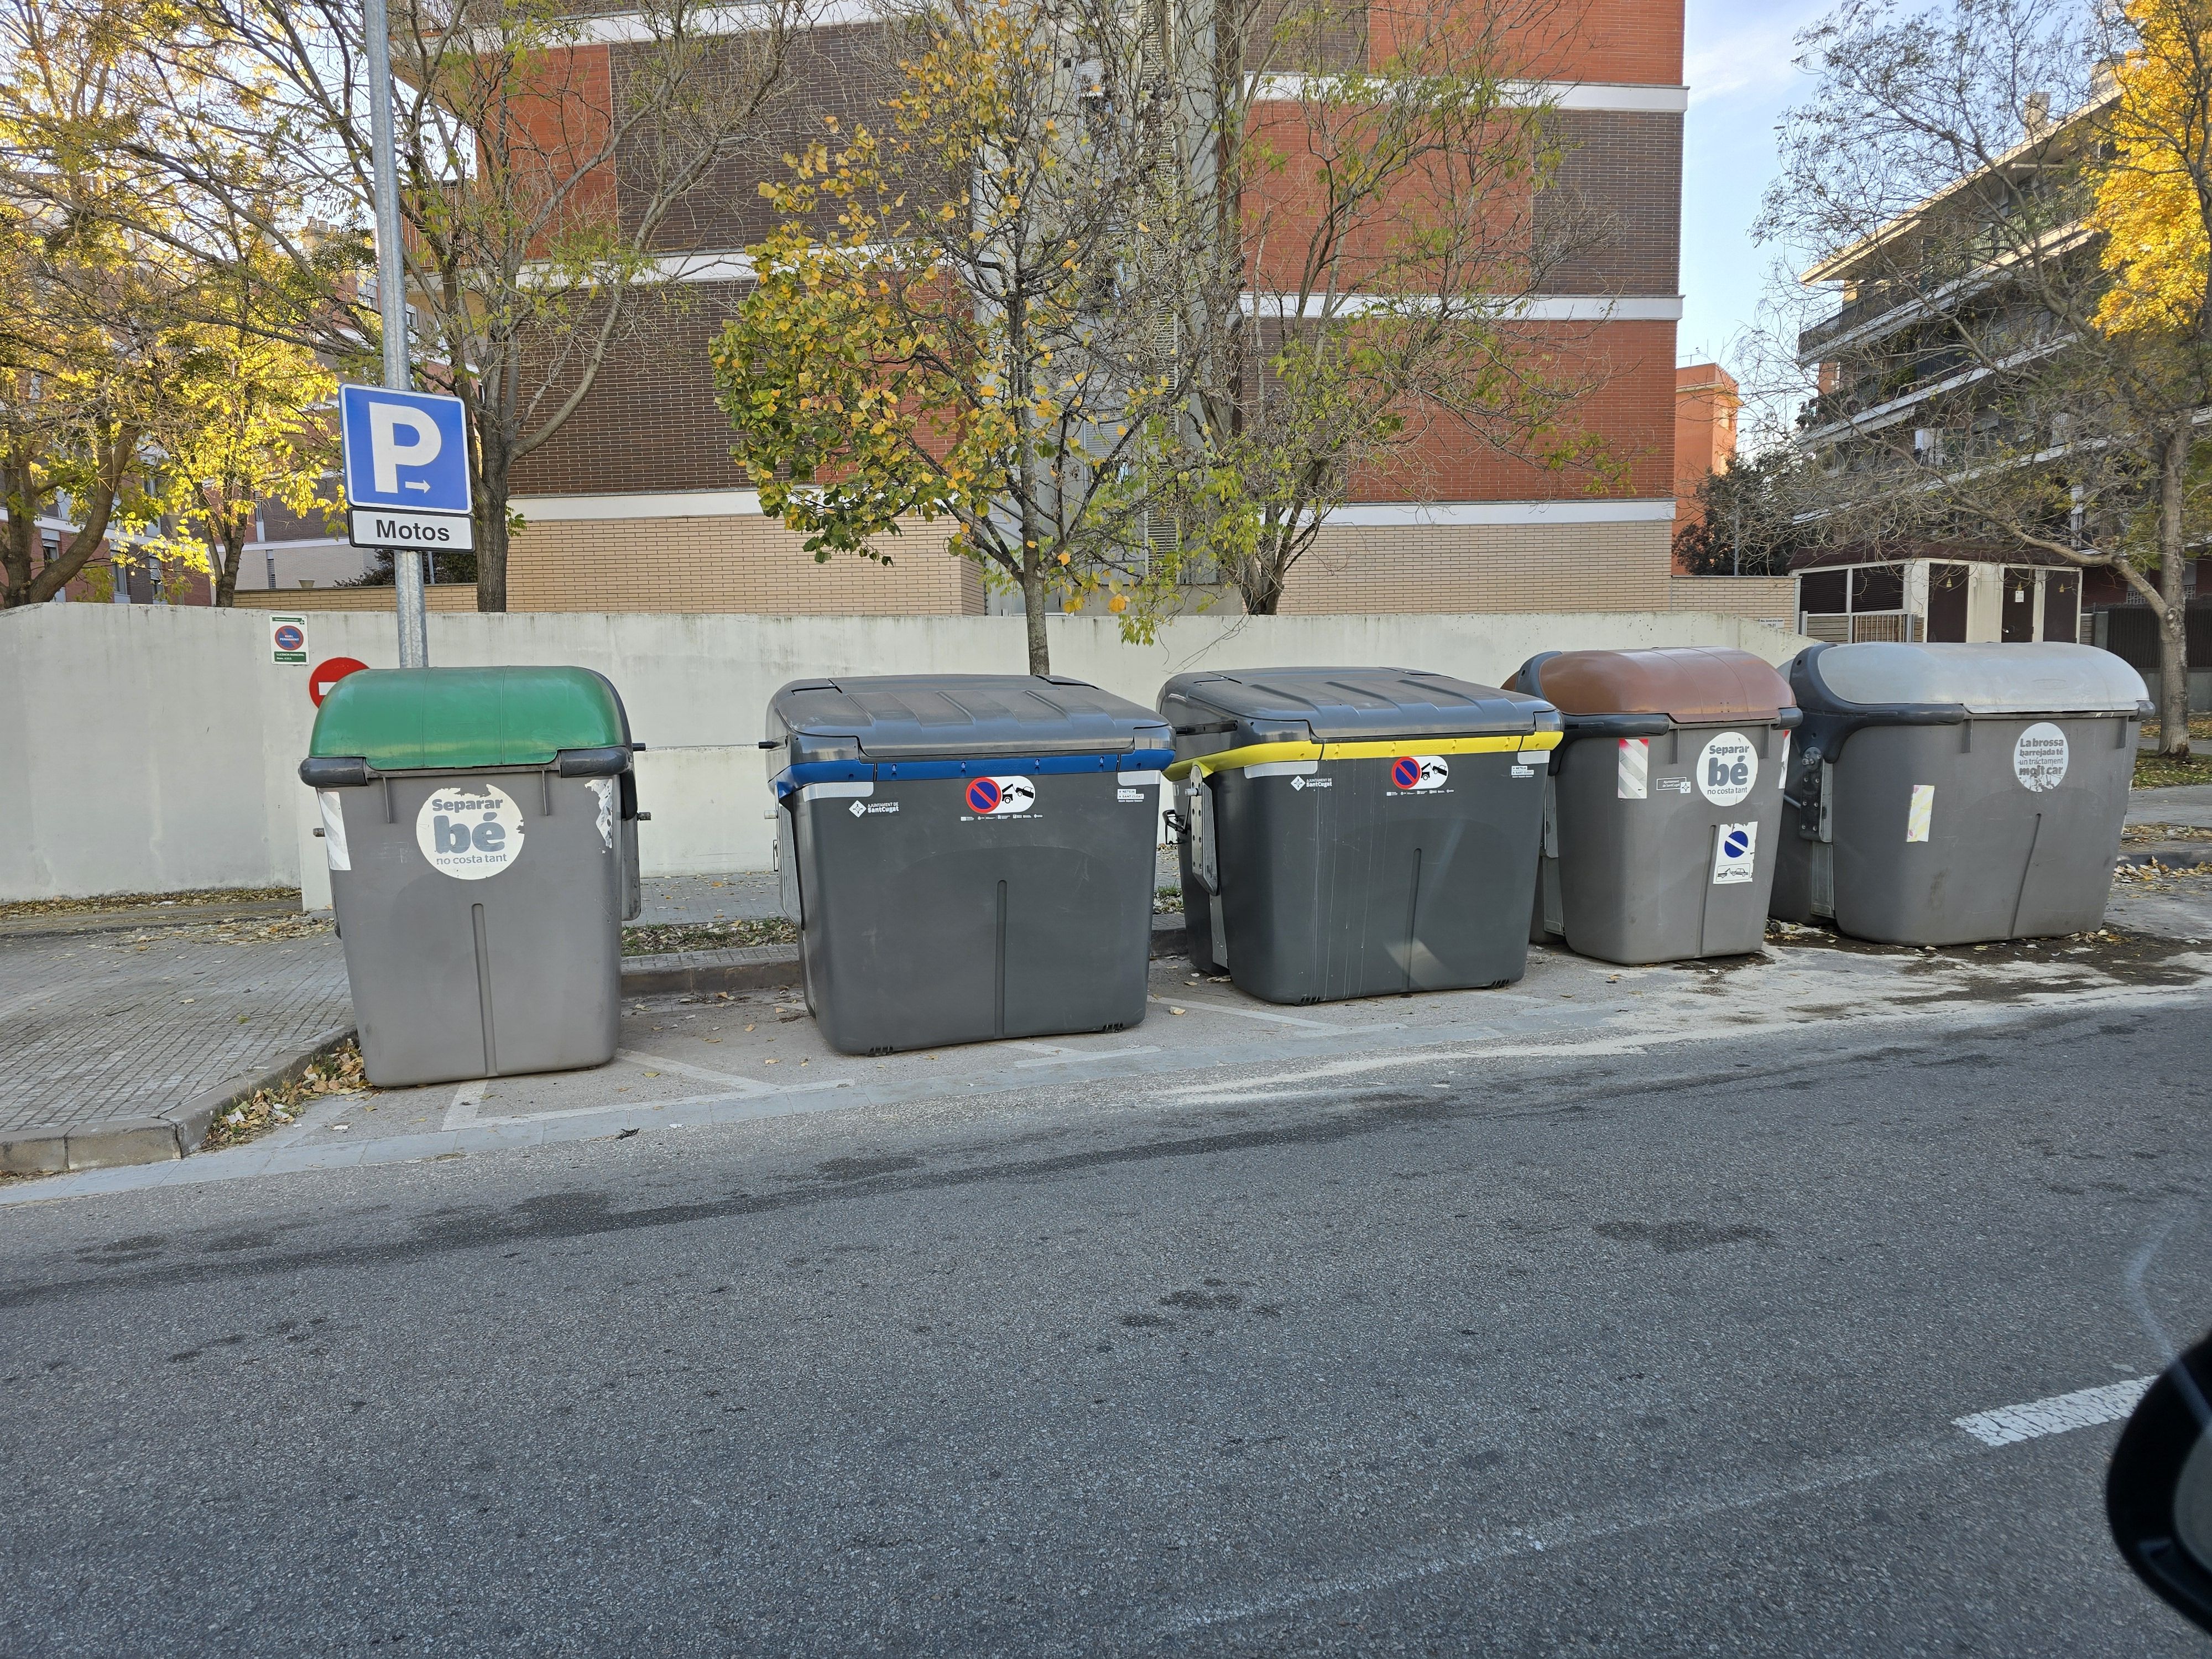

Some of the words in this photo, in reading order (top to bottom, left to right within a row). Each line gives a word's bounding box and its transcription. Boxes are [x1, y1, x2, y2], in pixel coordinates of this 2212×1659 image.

[369, 401, 442, 493] P
[376, 519, 450, 541] Motos
[2020, 738, 2032, 747] La
[2032, 738, 2064, 747] brossa
[1709, 745, 1749, 756] Separar
[2020, 748, 2056, 757] barrejada
[1708, 755, 1749, 786] bé
[2046, 766, 2063, 775] car
[432, 799, 503, 813] Separar
[434, 812, 506, 854] bé
[452, 855, 482, 864] costa
[485, 853, 507, 862] tant
